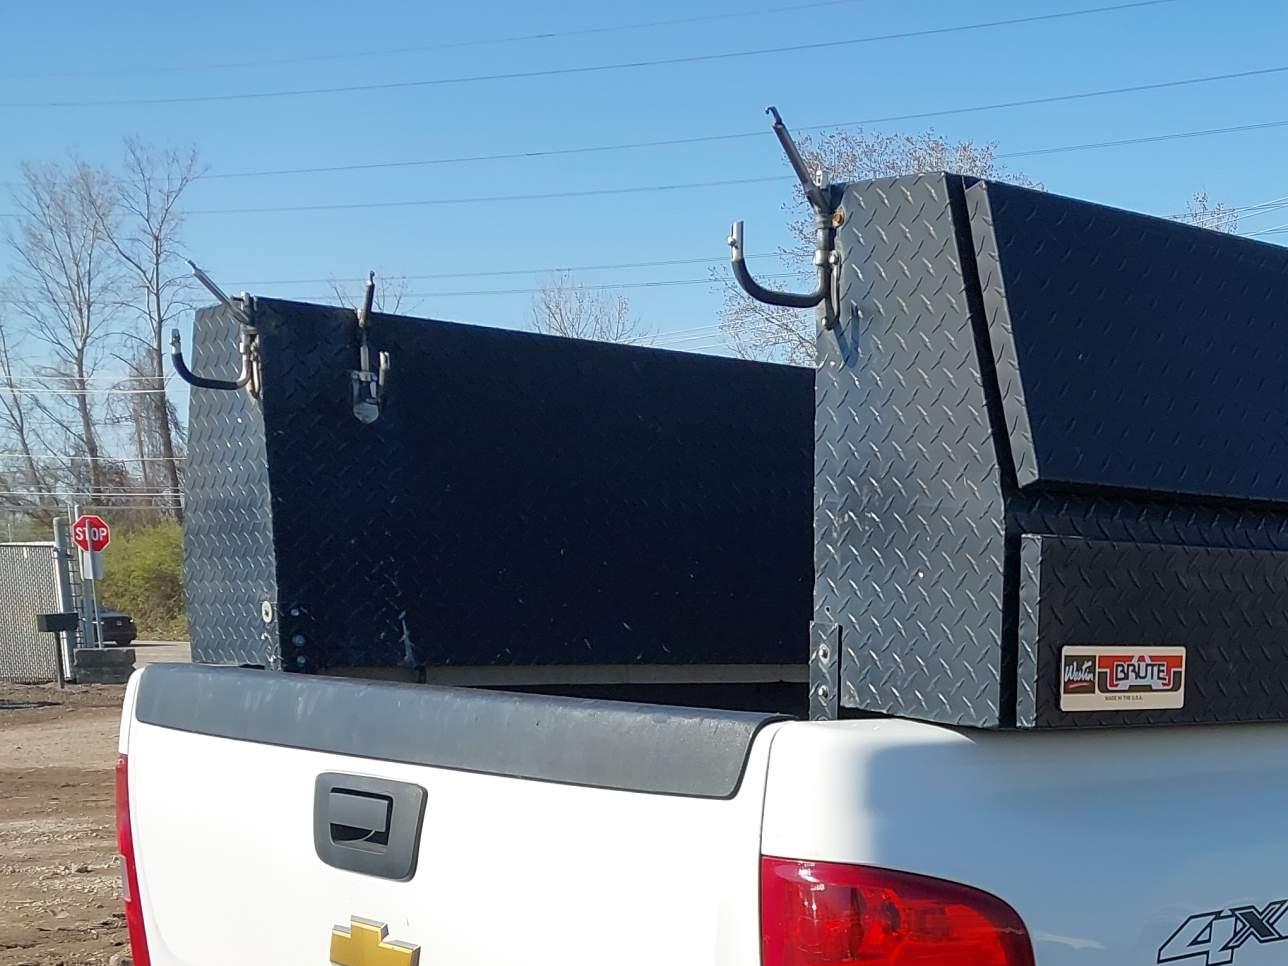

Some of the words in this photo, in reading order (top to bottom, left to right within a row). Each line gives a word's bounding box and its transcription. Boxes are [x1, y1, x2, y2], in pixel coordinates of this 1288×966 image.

[75, 527, 107, 541] STOP
[1064, 660, 1095, 682] Westin
[1114, 662, 1168, 683] BRUTE
